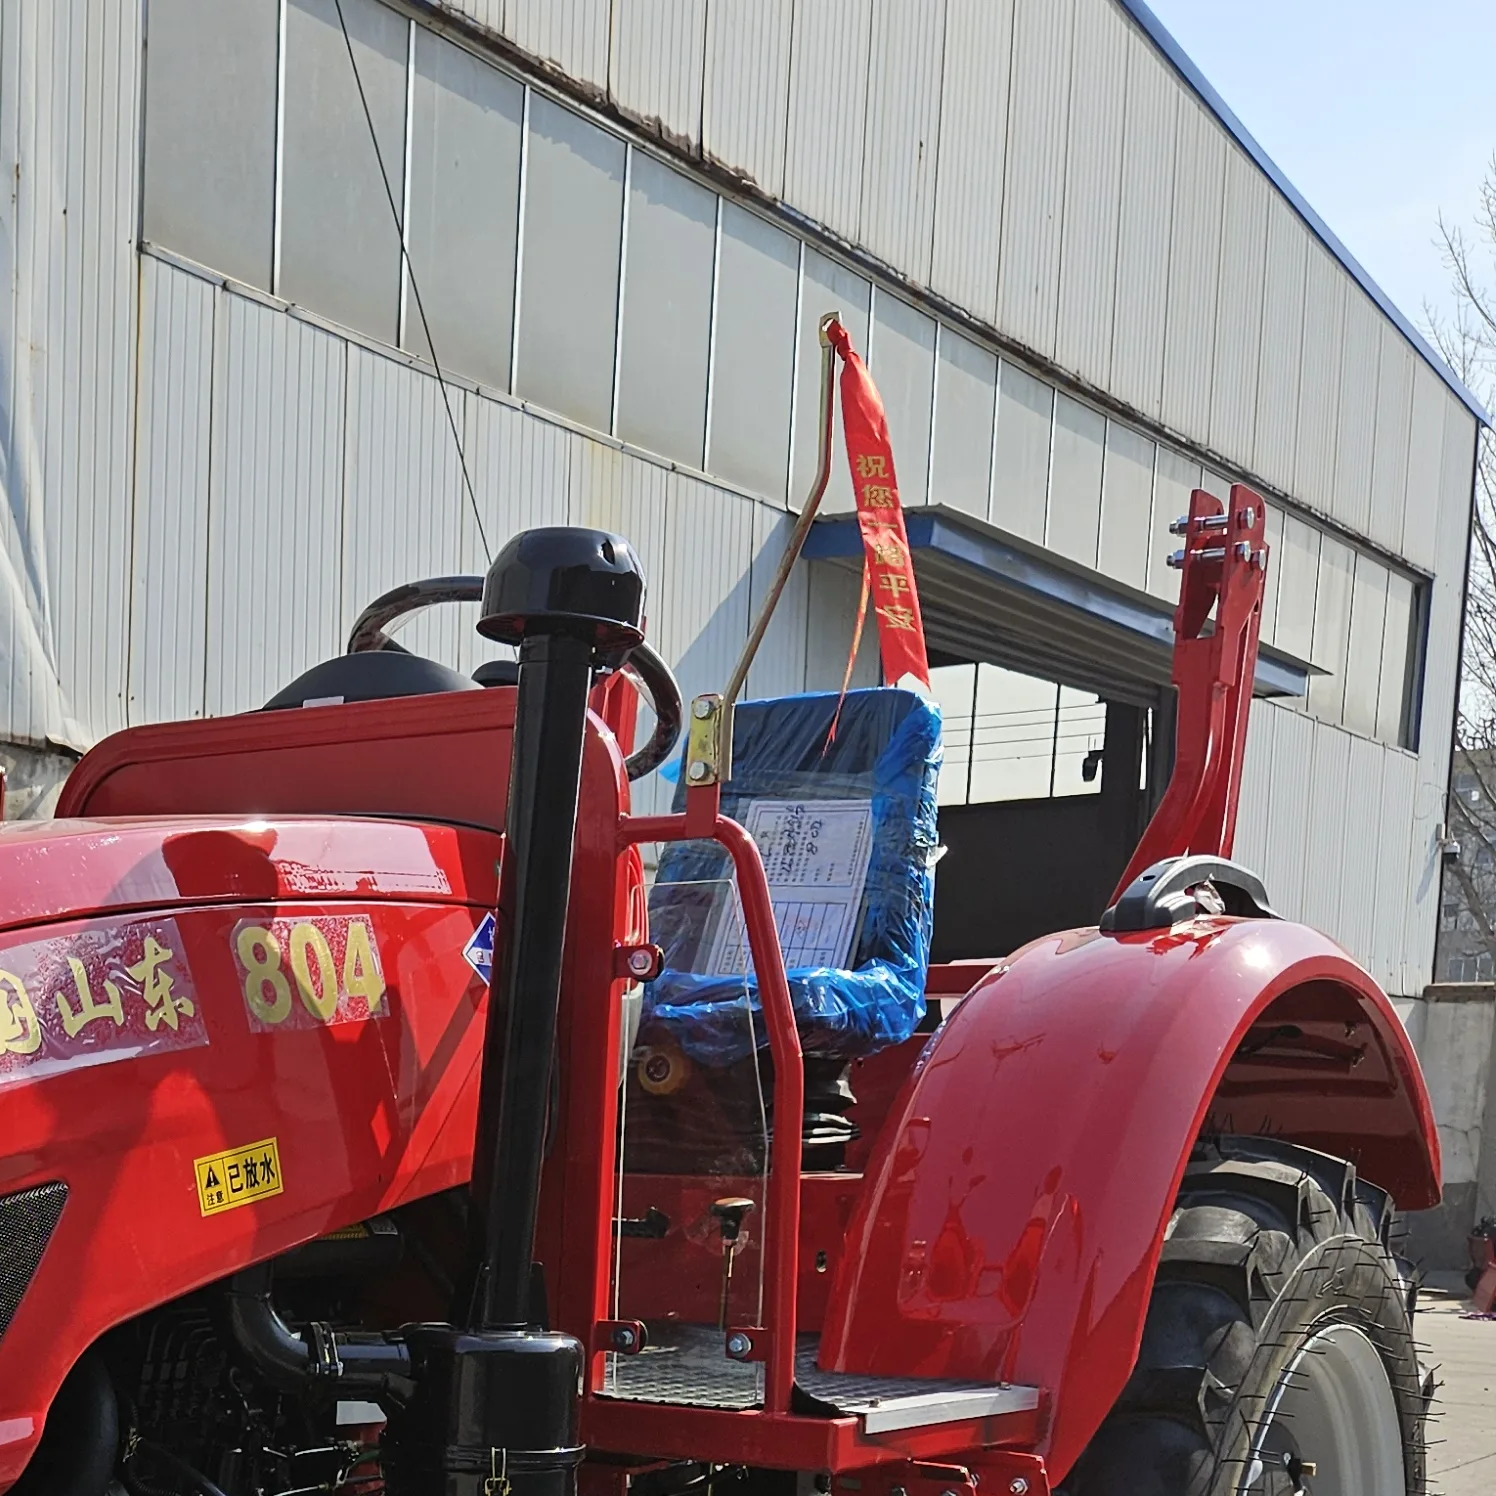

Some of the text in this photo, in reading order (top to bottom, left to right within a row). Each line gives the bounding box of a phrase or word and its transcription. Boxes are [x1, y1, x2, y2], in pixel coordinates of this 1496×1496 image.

[856, 454, 917, 632] 祝您一路平安
[236, 921, 385, 1025] 804
[206, 1190, 225, 1206] 注意
[227, 1152, 276, 1194] 已放水
